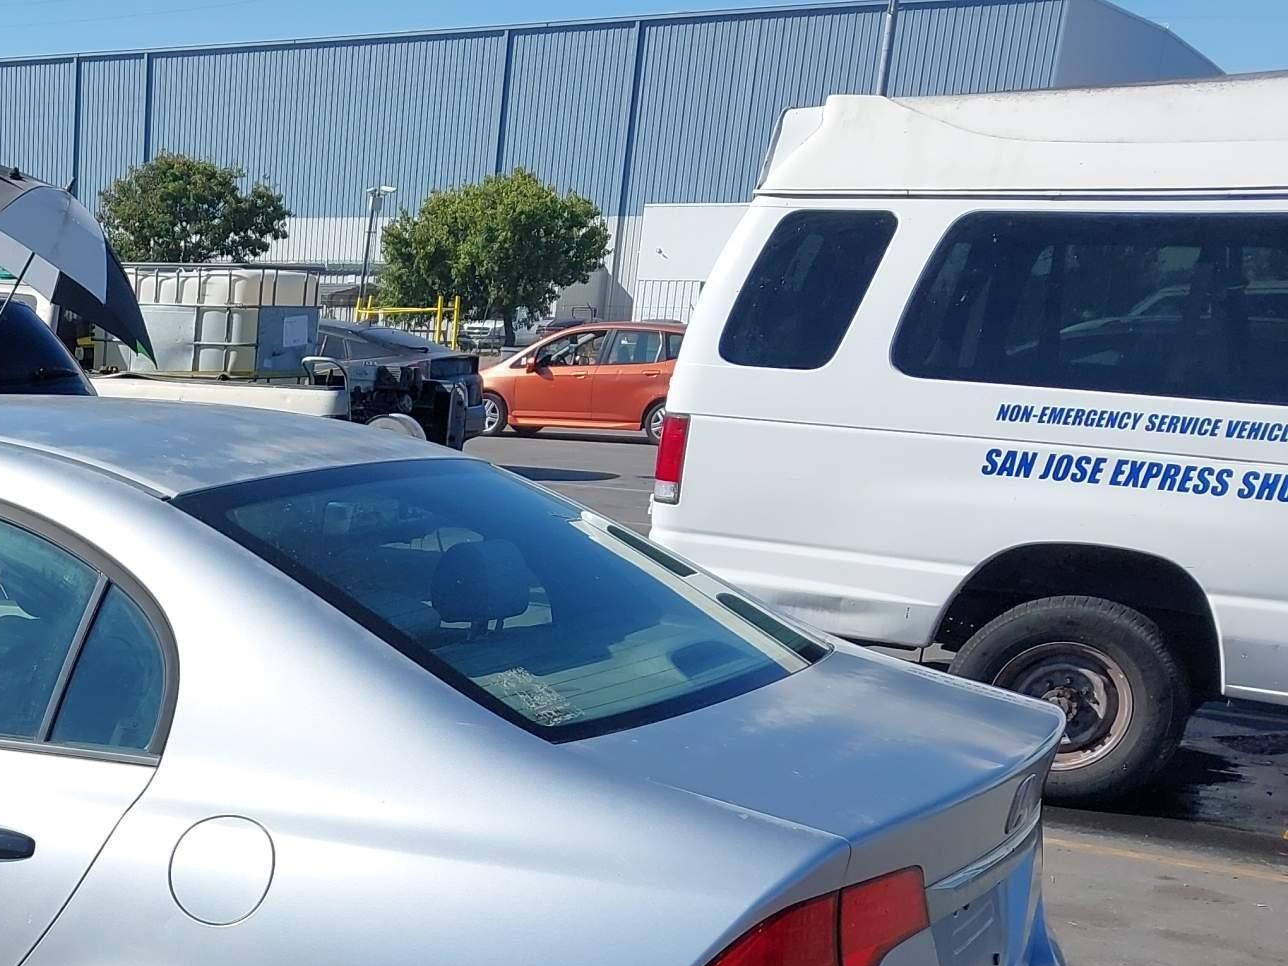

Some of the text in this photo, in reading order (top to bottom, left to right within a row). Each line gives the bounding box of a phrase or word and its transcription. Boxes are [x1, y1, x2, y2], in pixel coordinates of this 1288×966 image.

[996, 404, 1143, 432] NON-EMERGENCY
[1144, 414, 1222, 437] SERVICE
[981, 448, 1039, 479] SAN
[1039, 452, 1107, 485] JOSE
[1109, 458, 1234, 497] EXPRESS
